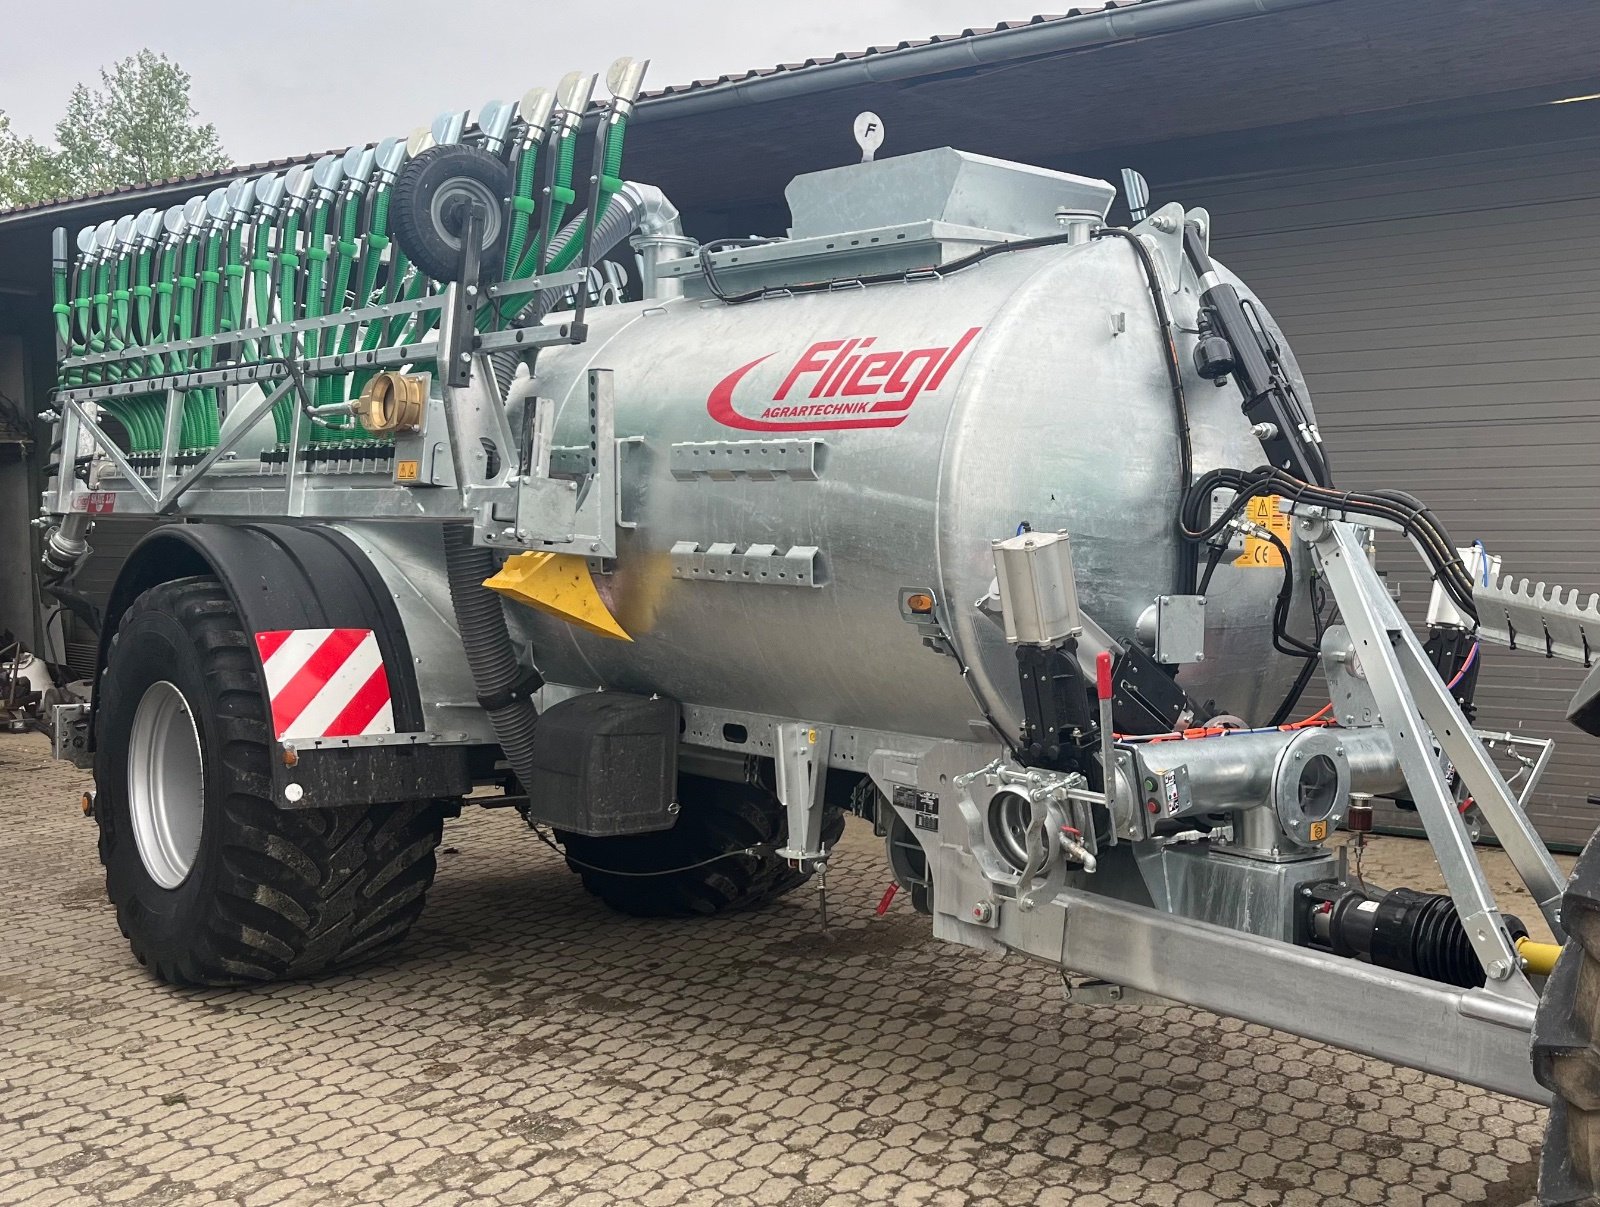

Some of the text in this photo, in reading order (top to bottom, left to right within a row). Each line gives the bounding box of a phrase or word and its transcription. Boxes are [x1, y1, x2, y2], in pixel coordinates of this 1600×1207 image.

[864, 123, 877, 138] F
[772, 326, 983, 413] Fliegl
[760, 402, 870, 418] AGRARTECHNIK
